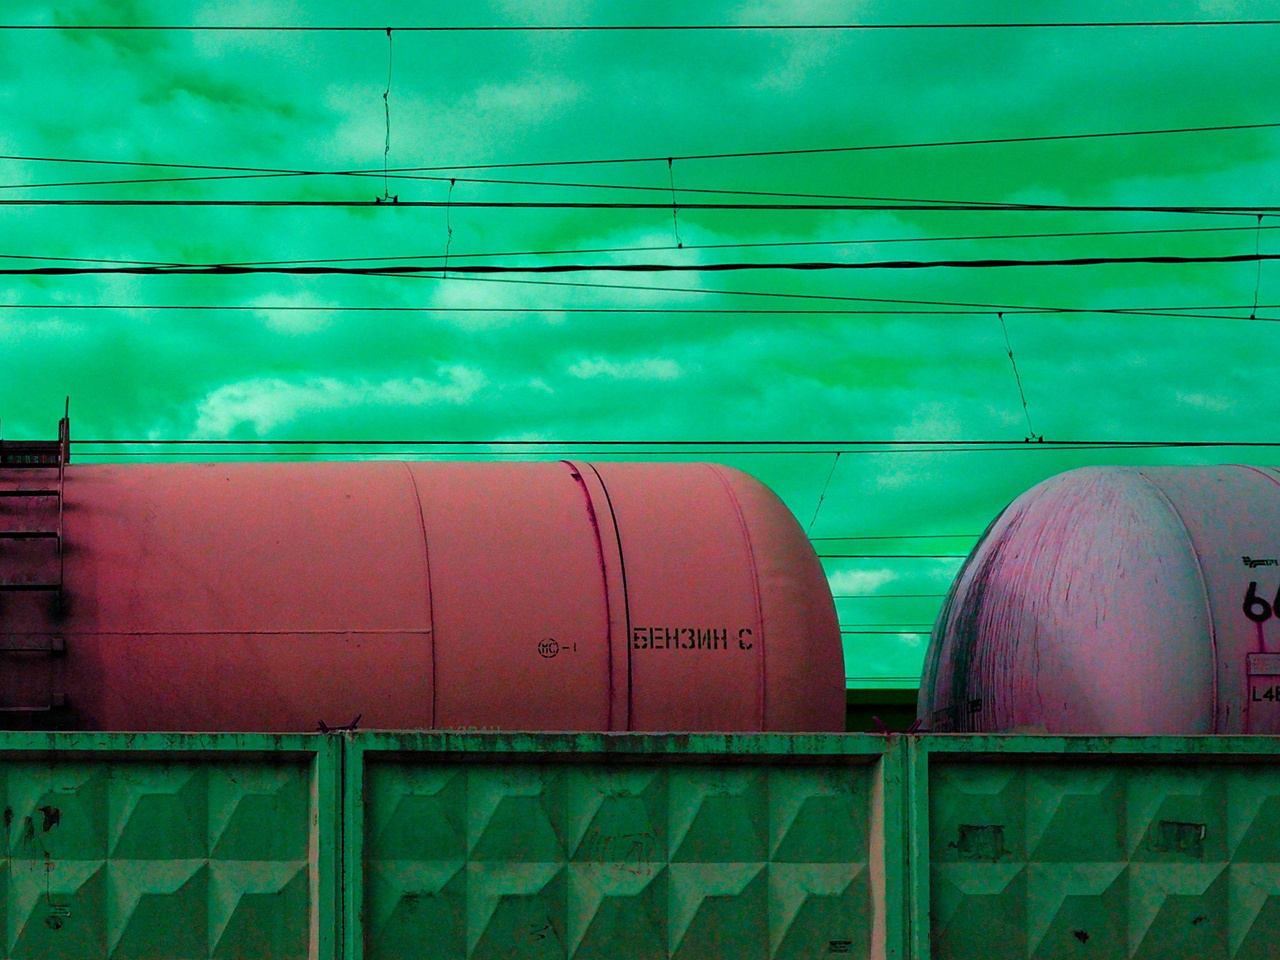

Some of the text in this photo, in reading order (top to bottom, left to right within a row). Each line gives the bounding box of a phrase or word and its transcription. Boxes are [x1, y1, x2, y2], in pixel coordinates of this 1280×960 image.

[1243, 581, 1280, 622] 6
[633, 627, 753, 650] БЕНЗИН С
